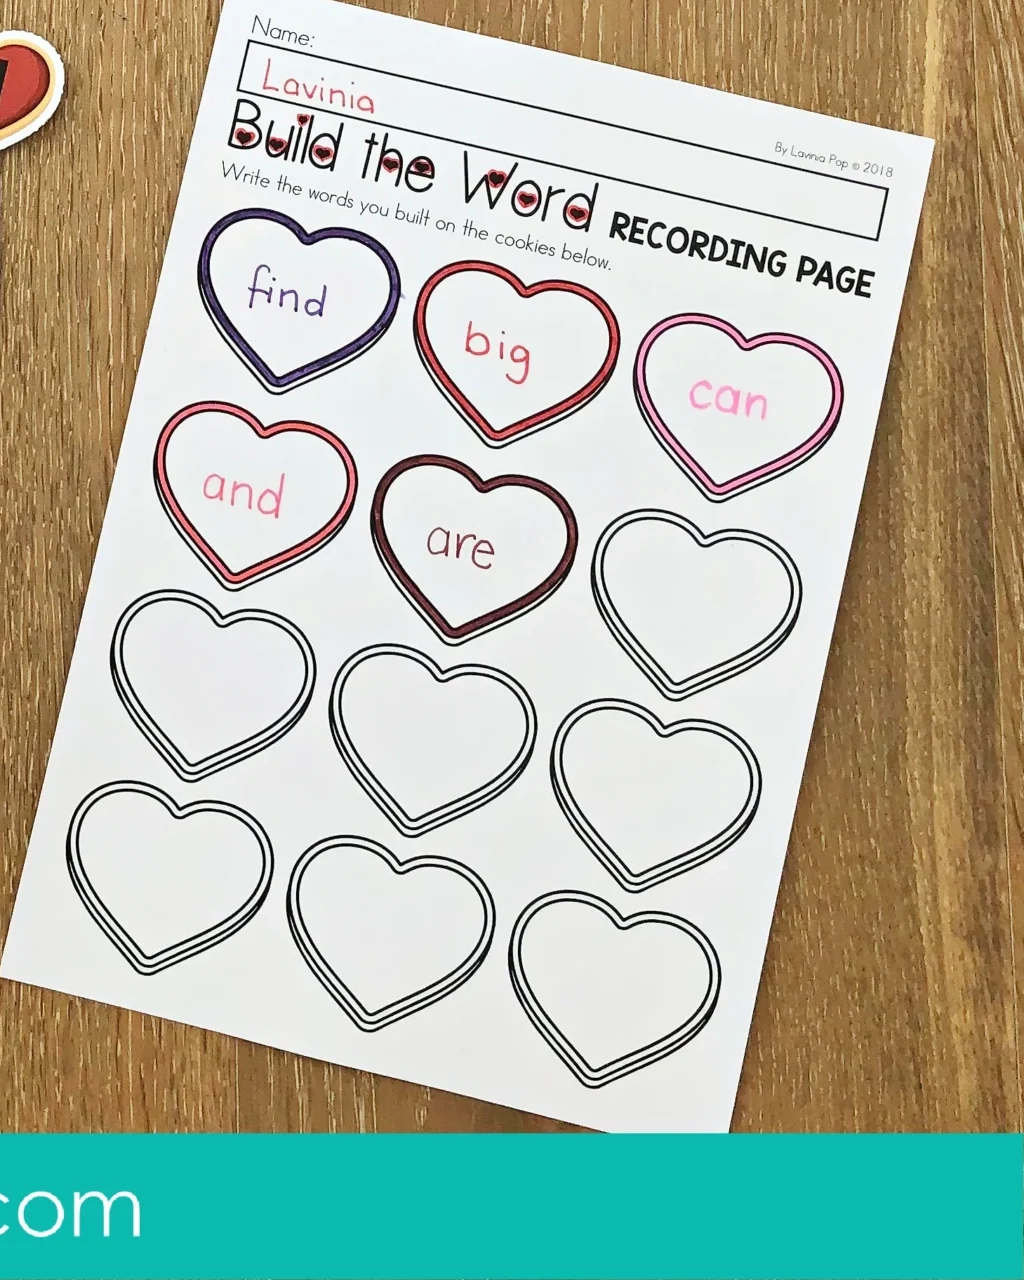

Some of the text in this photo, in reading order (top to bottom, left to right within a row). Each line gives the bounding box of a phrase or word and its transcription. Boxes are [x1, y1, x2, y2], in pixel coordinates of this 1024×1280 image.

[251, 15, 315, 48] Name:
[262, 58, 375, 114] Lavinia
[774, 141, 788, 157] By
[790, 145, 826, 164] Lavinia
[829, 153, 849, 171] Pop
[863, 161, 894, 178] 2018
[221, 160, 612, 271] Write the words you built on the cookies below.
[228, 98, 875, 298] Build the Word RECORDING PAGE
[247, 264, 326, 318] find
[465, 321, 531, 385] big
[688, 377, 767, 420] can
[203, 472, 286, 519] and
[426, 525, 496, 570] are
